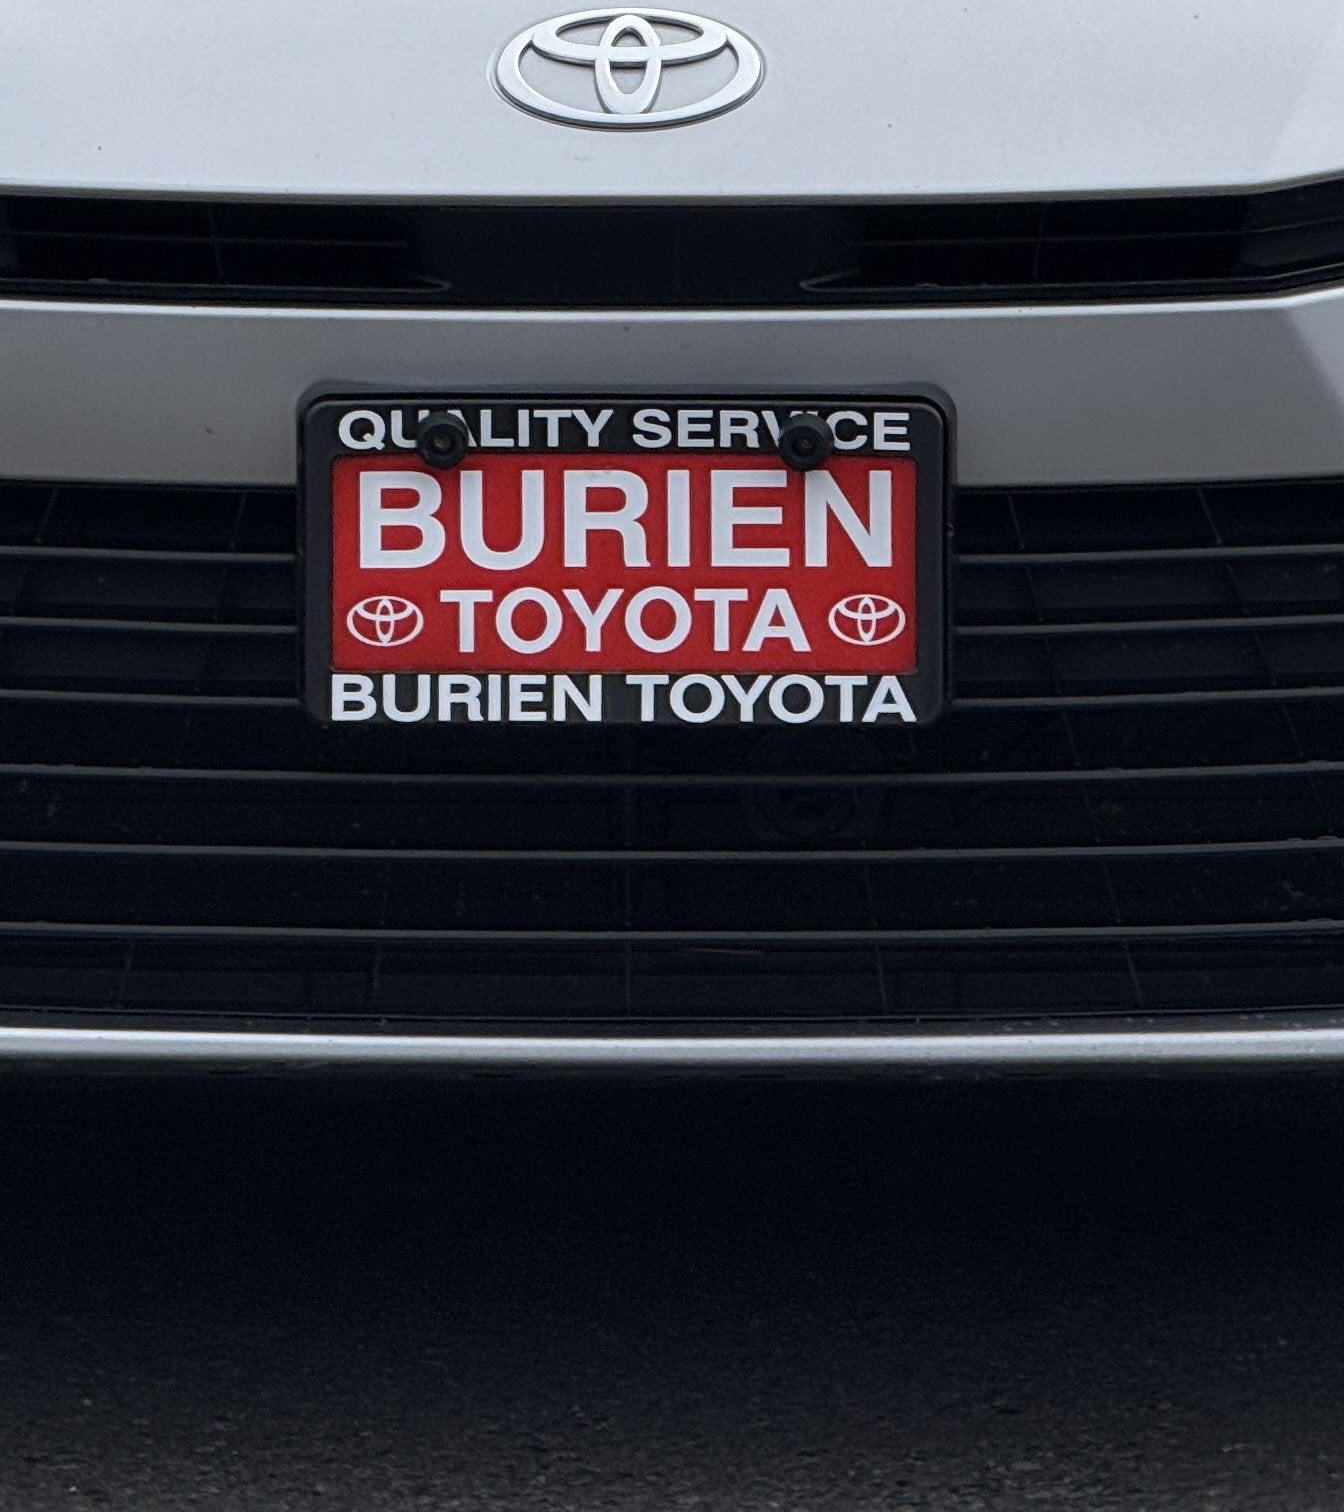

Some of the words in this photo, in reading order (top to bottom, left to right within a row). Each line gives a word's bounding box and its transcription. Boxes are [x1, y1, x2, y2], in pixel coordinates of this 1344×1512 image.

[632, 409, 911, 451] SERVCE
[358, 468, 894, 571] BURIEN
[439, 585, 812, 654] TOYOTA
[330, 674, 602, 723] BURIEN
[625, 674, 917, 723] TOYOTA
